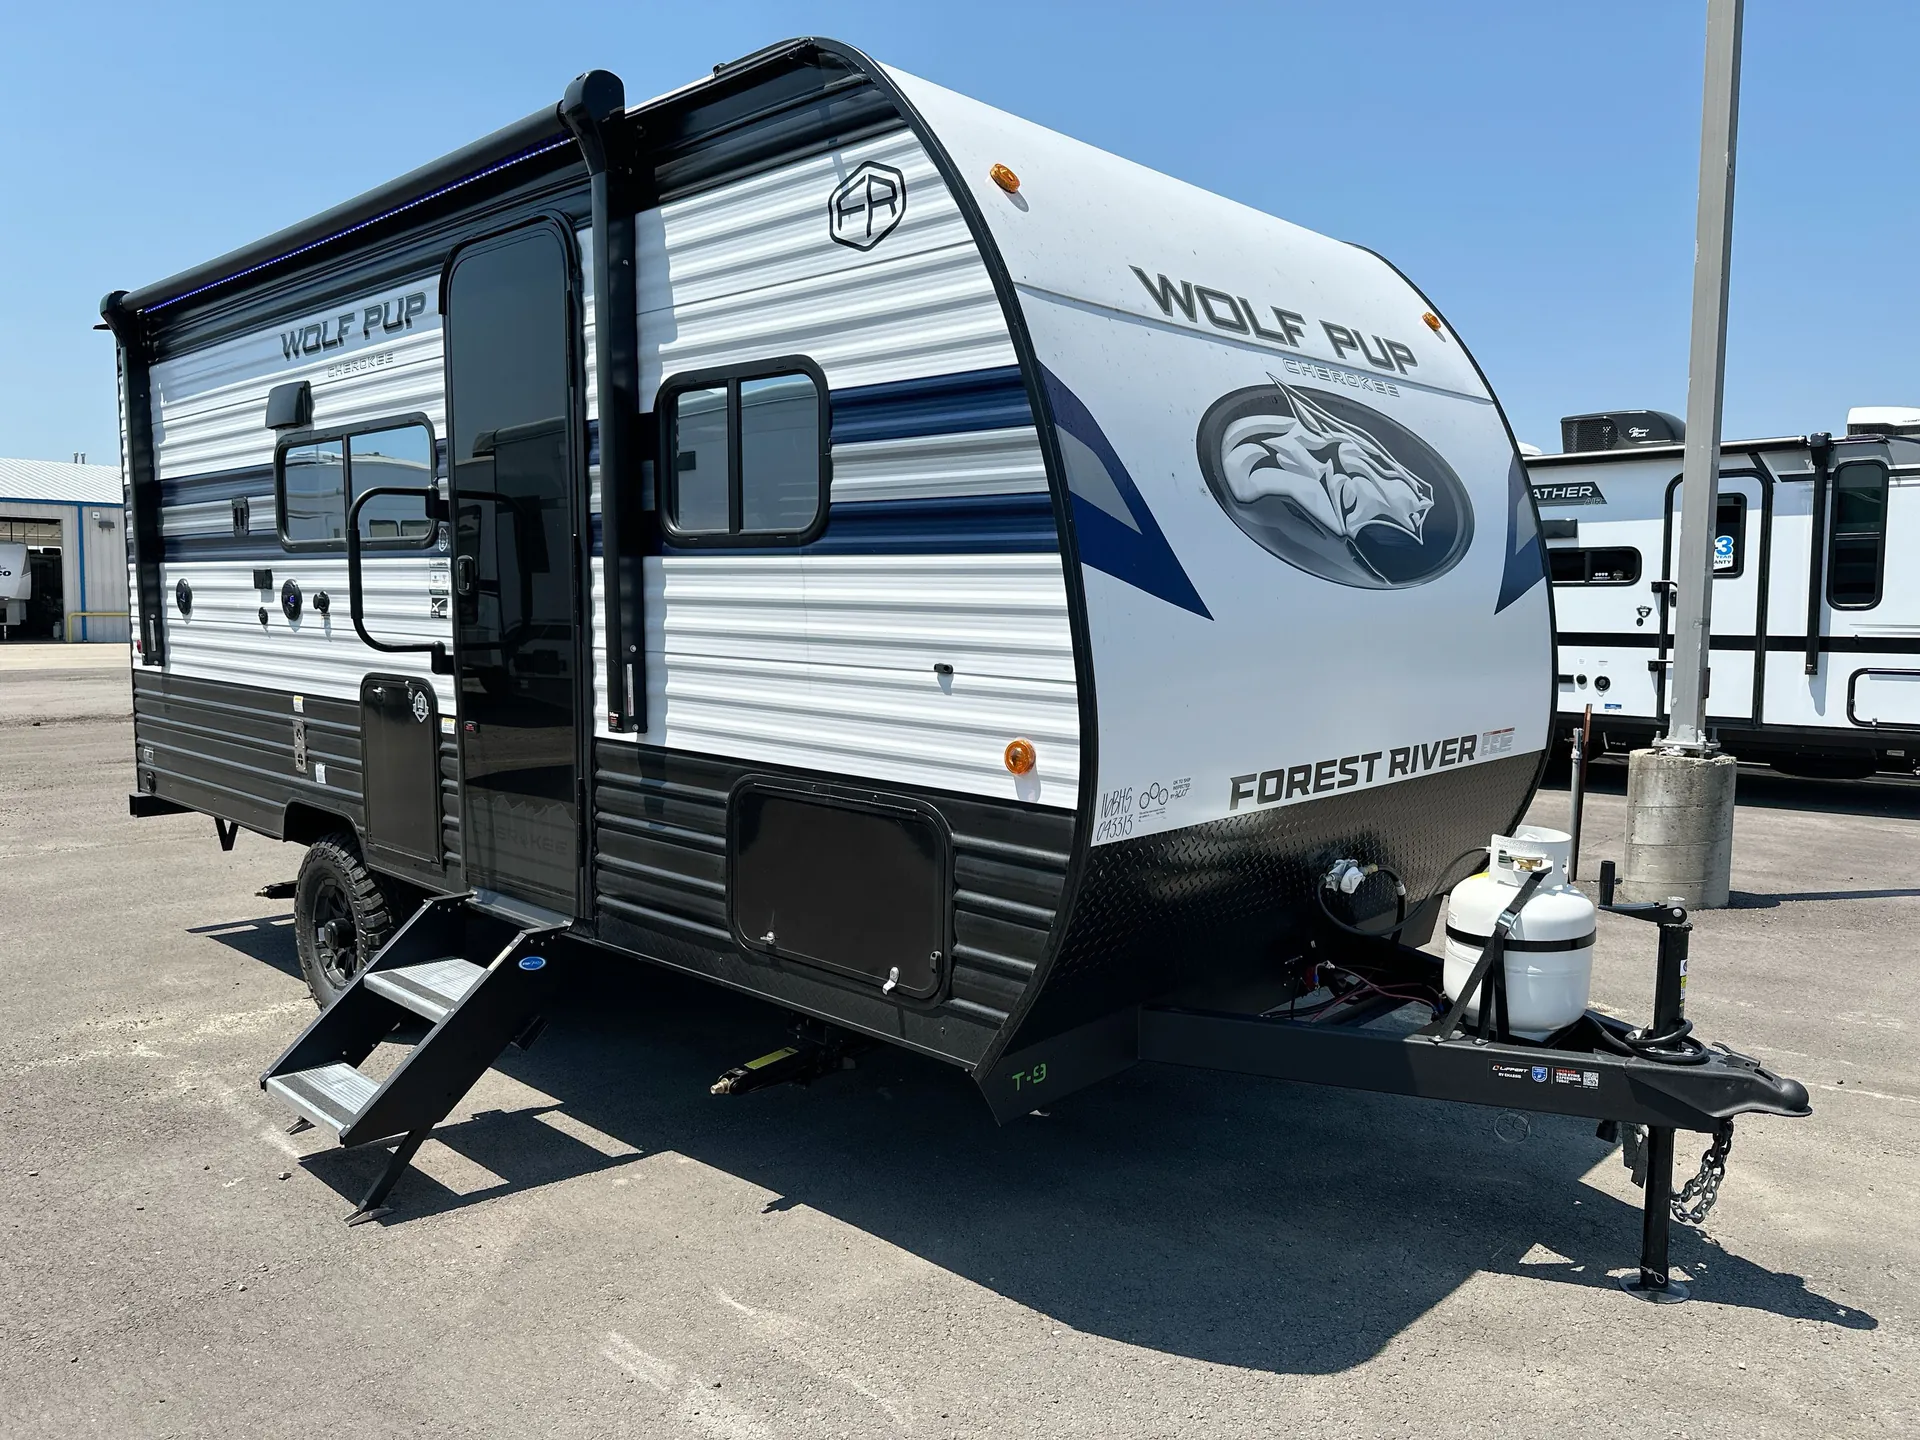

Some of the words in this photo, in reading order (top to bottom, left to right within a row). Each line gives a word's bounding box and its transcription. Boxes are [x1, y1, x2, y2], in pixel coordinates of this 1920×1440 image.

[280, 312, 355, 361] WOLF
[363, 292, 426, 340] PUP
[1128, 264, 1306, 348] WOLF
[1319, 319, 1419, 375] PUP
[327, 351, 394, 378] CHEROKEE
[1283, 358, 1400, 397] CHEROKEE
[1229, 751, 1382, 811] FOREST
[1388, 734, 1478, 779] RIVER
